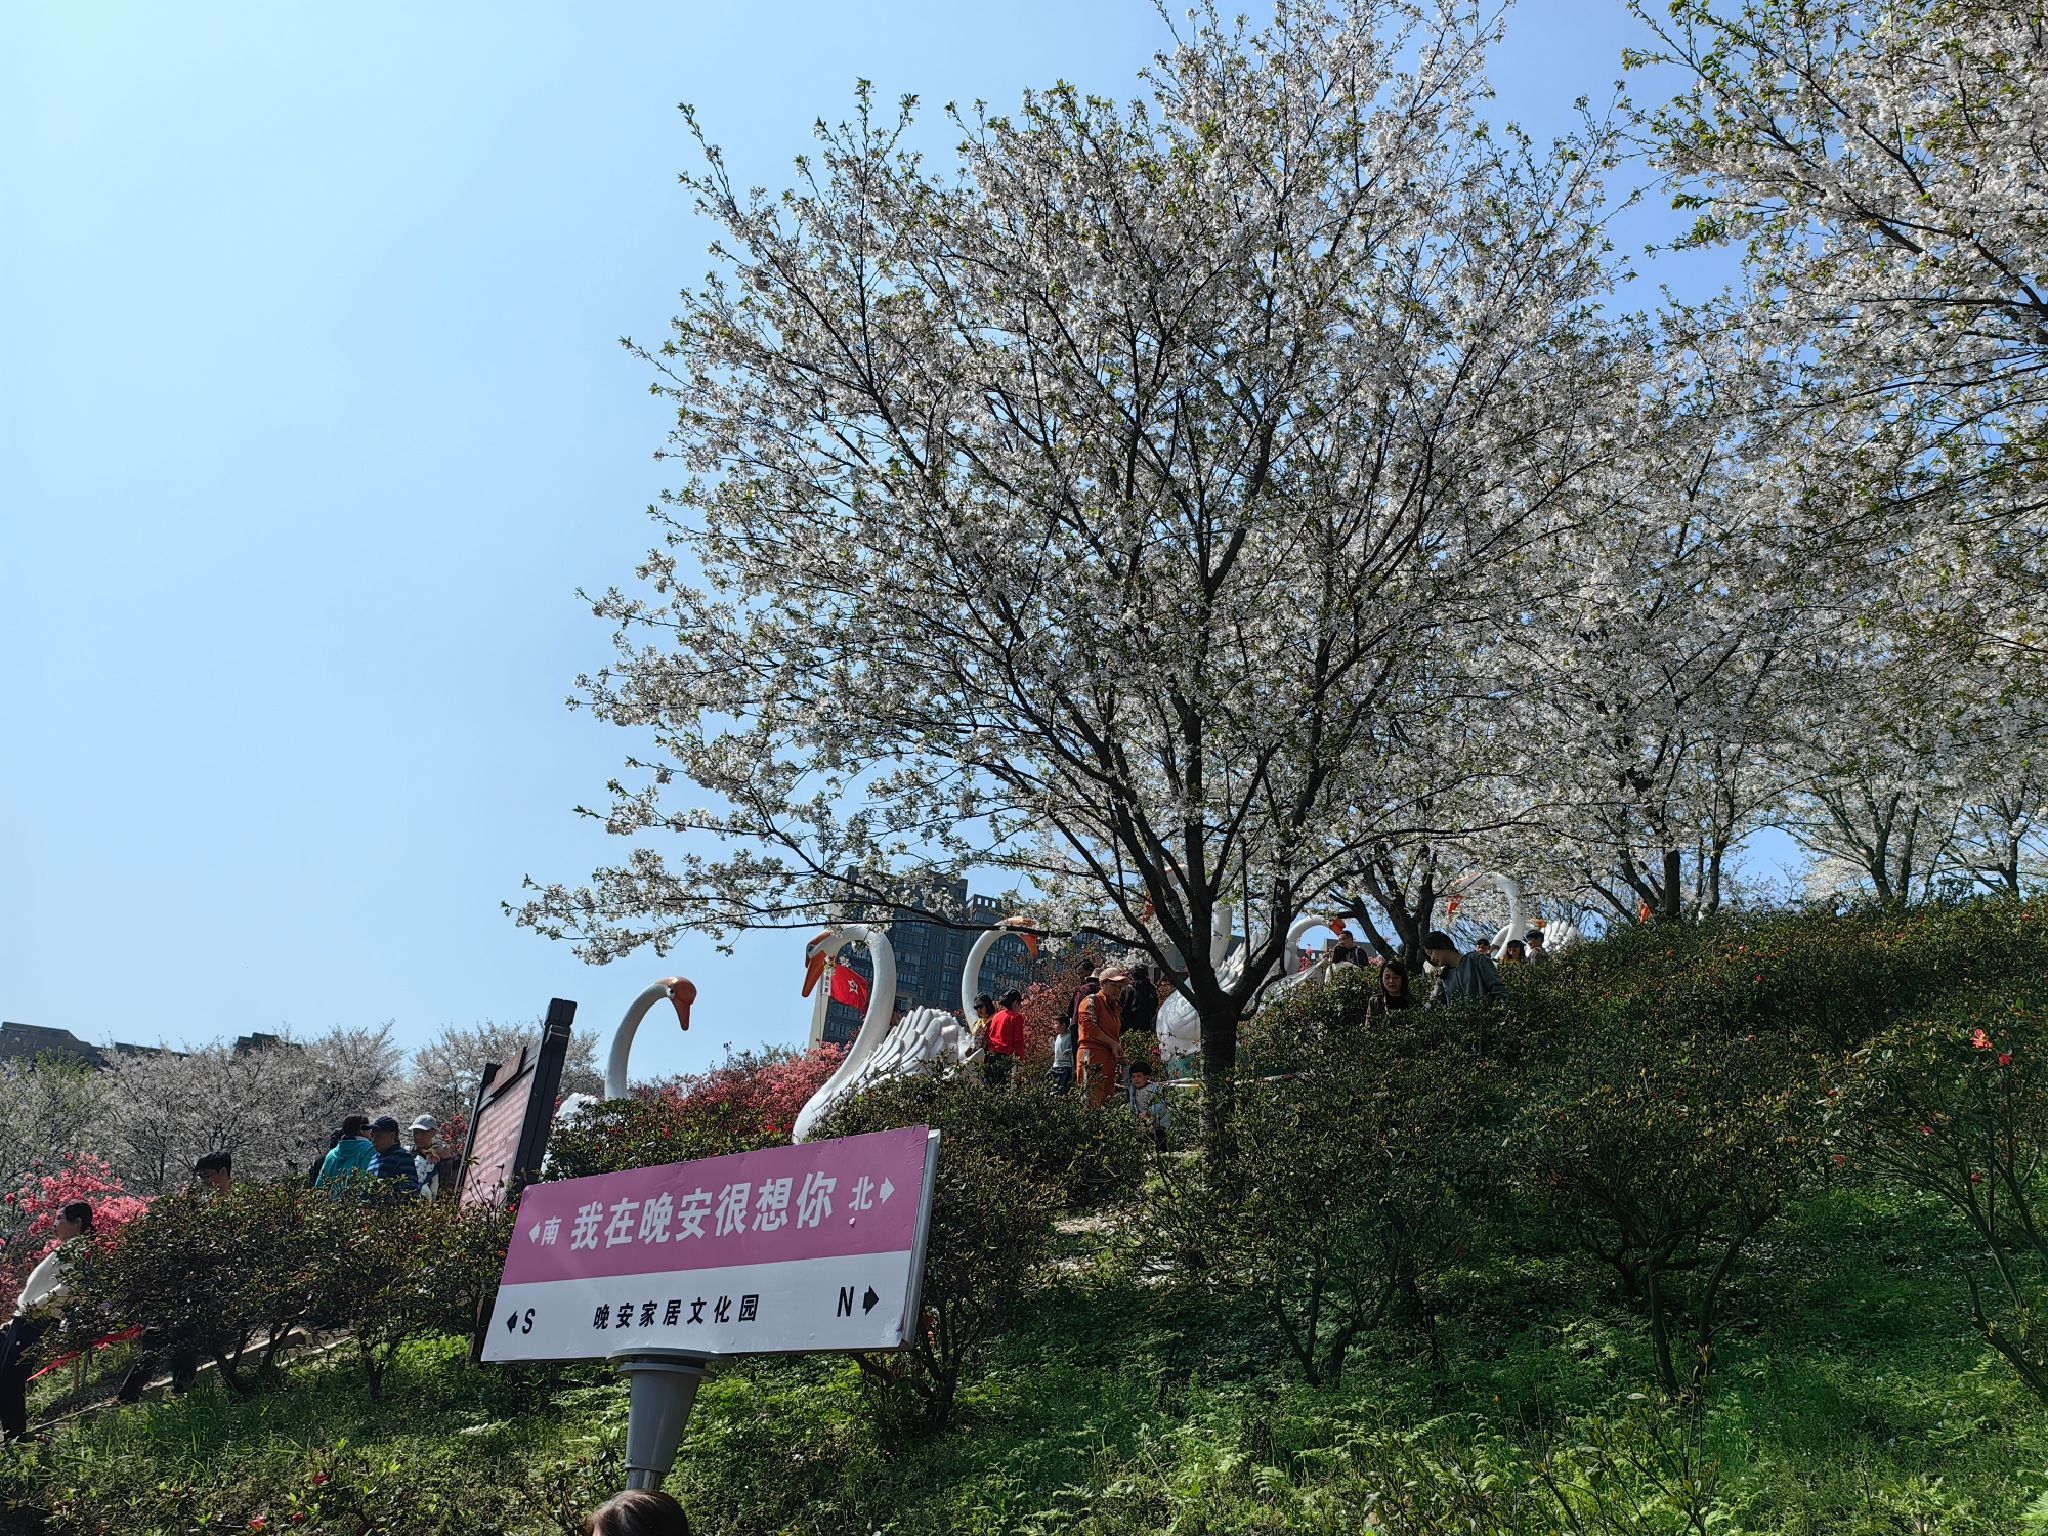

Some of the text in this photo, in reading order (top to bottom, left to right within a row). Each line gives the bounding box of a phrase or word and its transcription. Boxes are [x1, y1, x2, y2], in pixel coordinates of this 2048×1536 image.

[541, 1171, 875, 1251] 南 我在晚安很想你 北
[592, 1294, 760, 1331] 晚安家居文化园
[837, 1286, 855, 1318] N
[521, 1308, 536, 1335] S
